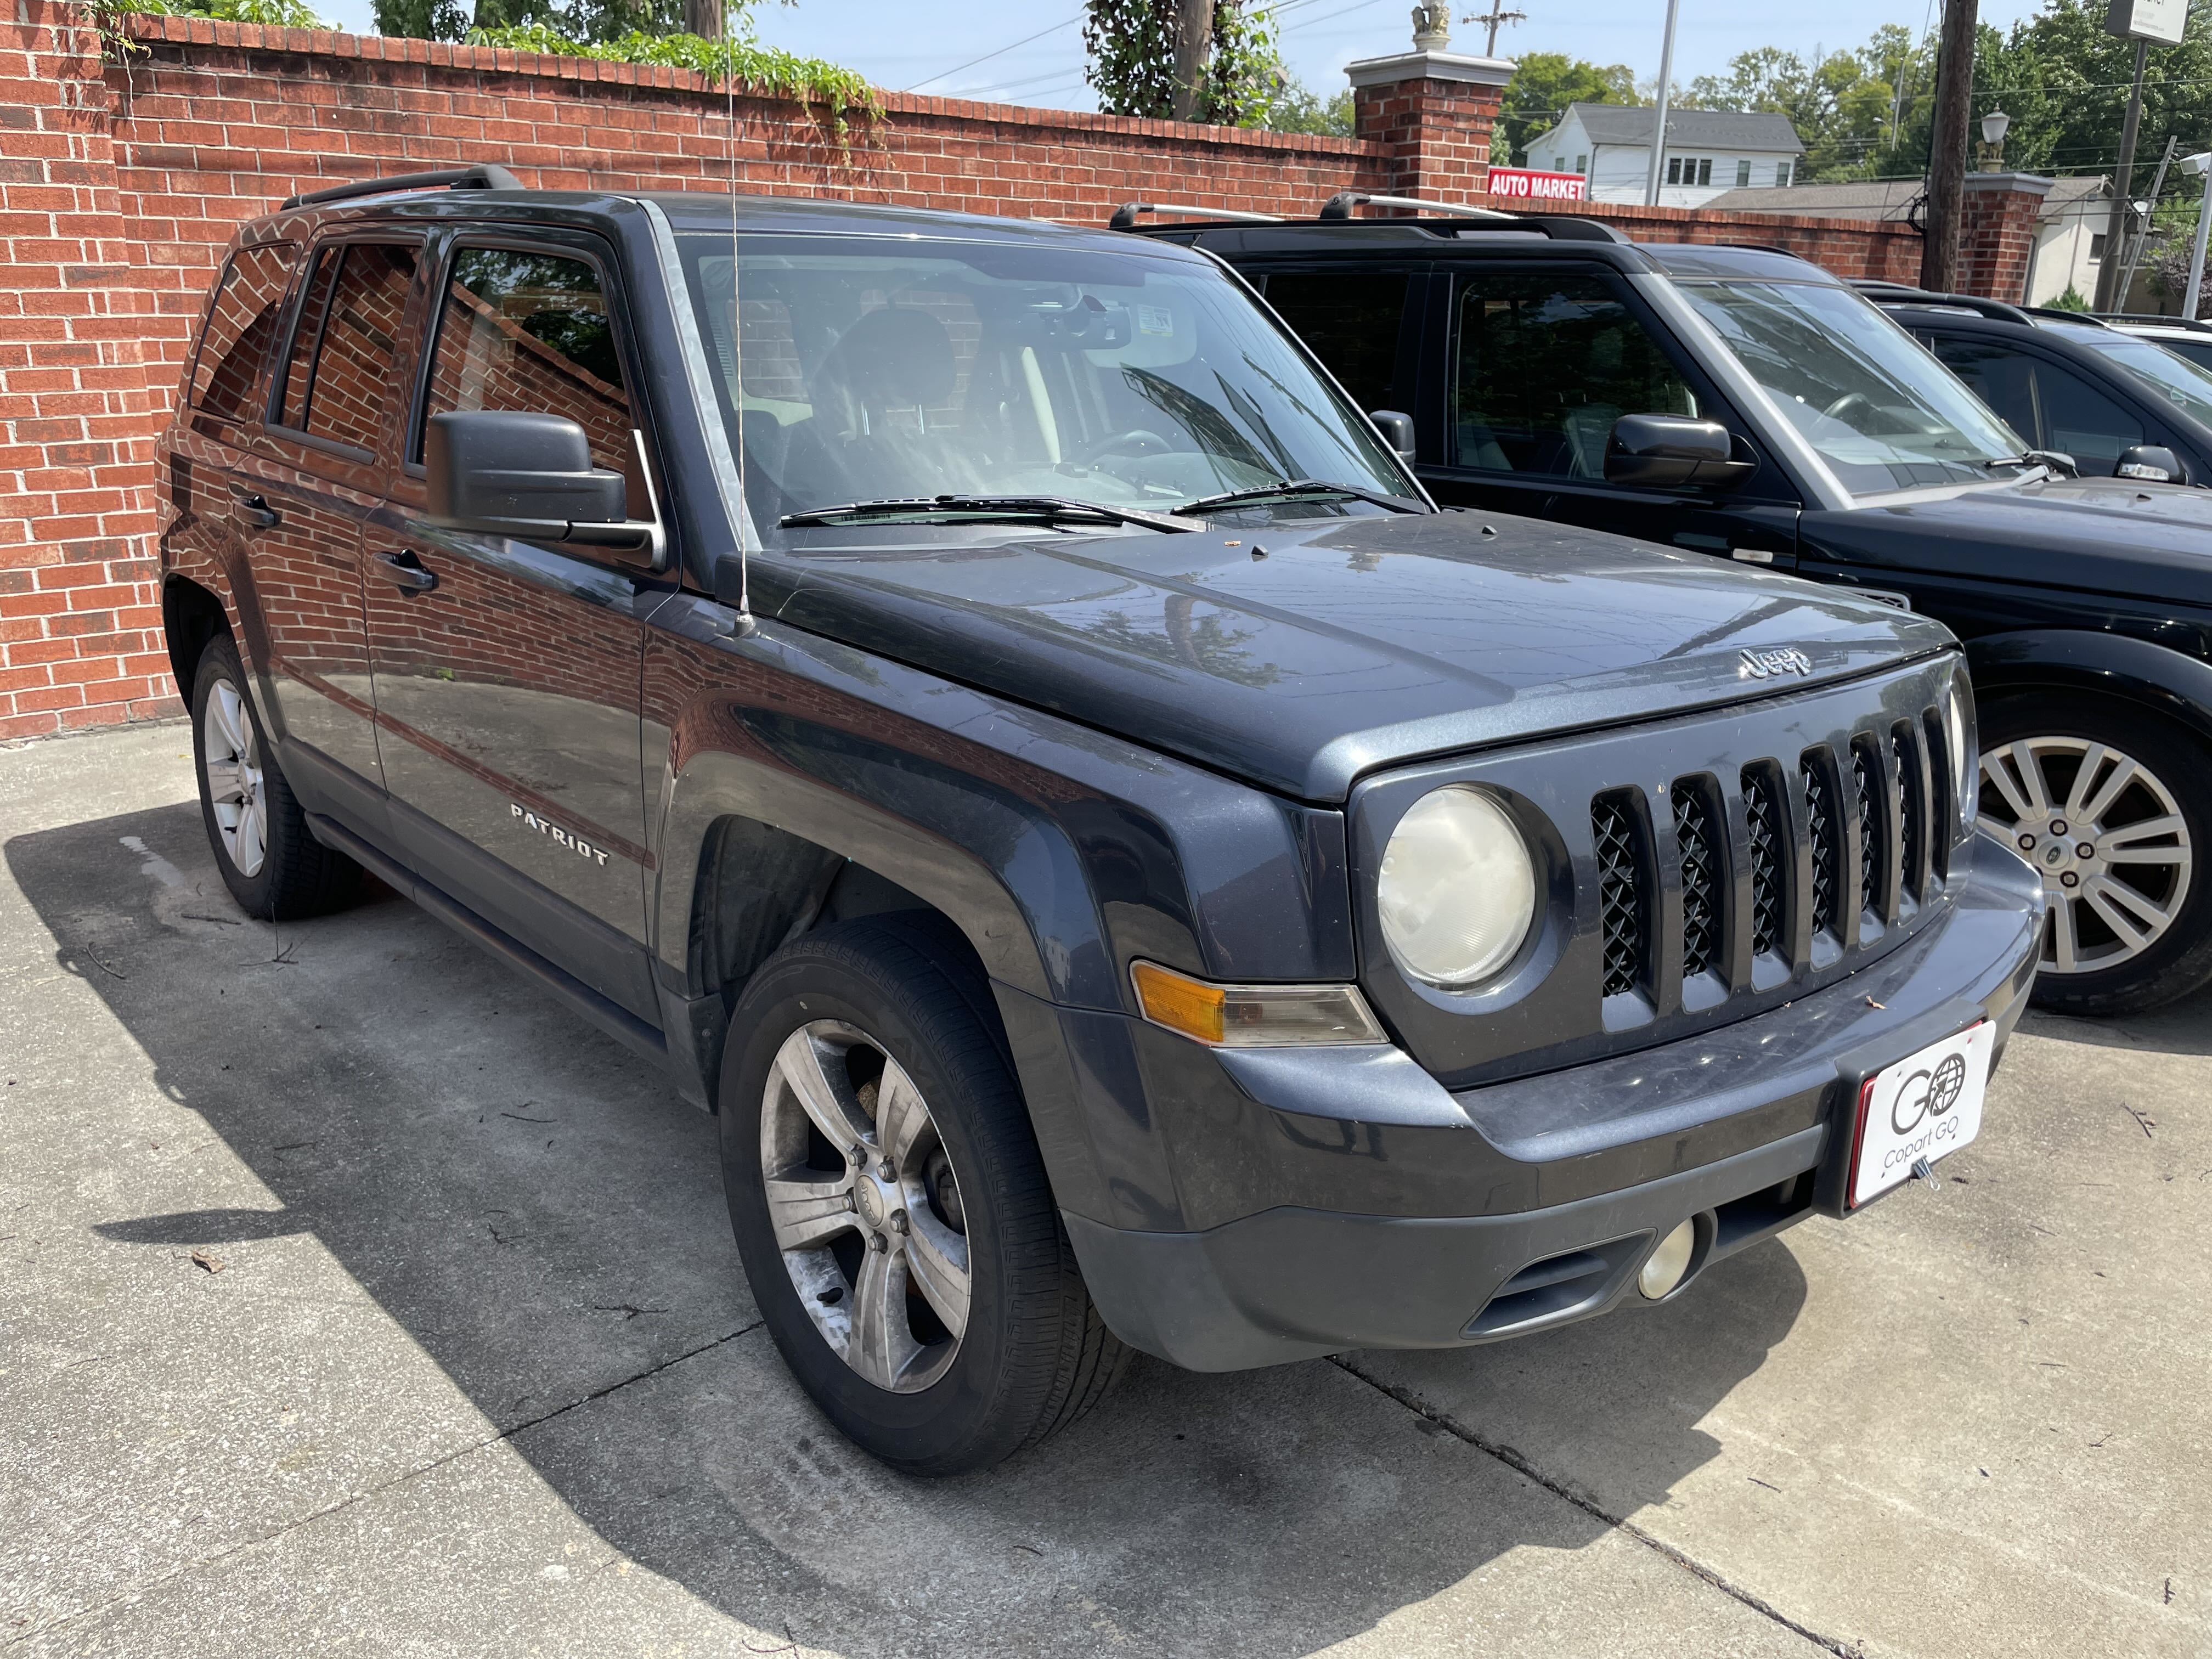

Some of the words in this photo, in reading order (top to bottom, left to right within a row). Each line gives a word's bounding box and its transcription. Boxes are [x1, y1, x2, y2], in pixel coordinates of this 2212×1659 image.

[1490, 174, 1528, 196] AUTO
[1531, 177, 1585, 200] MARKET
[1739, 647, 1810, 679] Jeep
[511, 803, 609, 866] PATRIOT
[1884, 1128, 1932, 1168] Copart
[1936, 1116, 1959, 1140] GO
